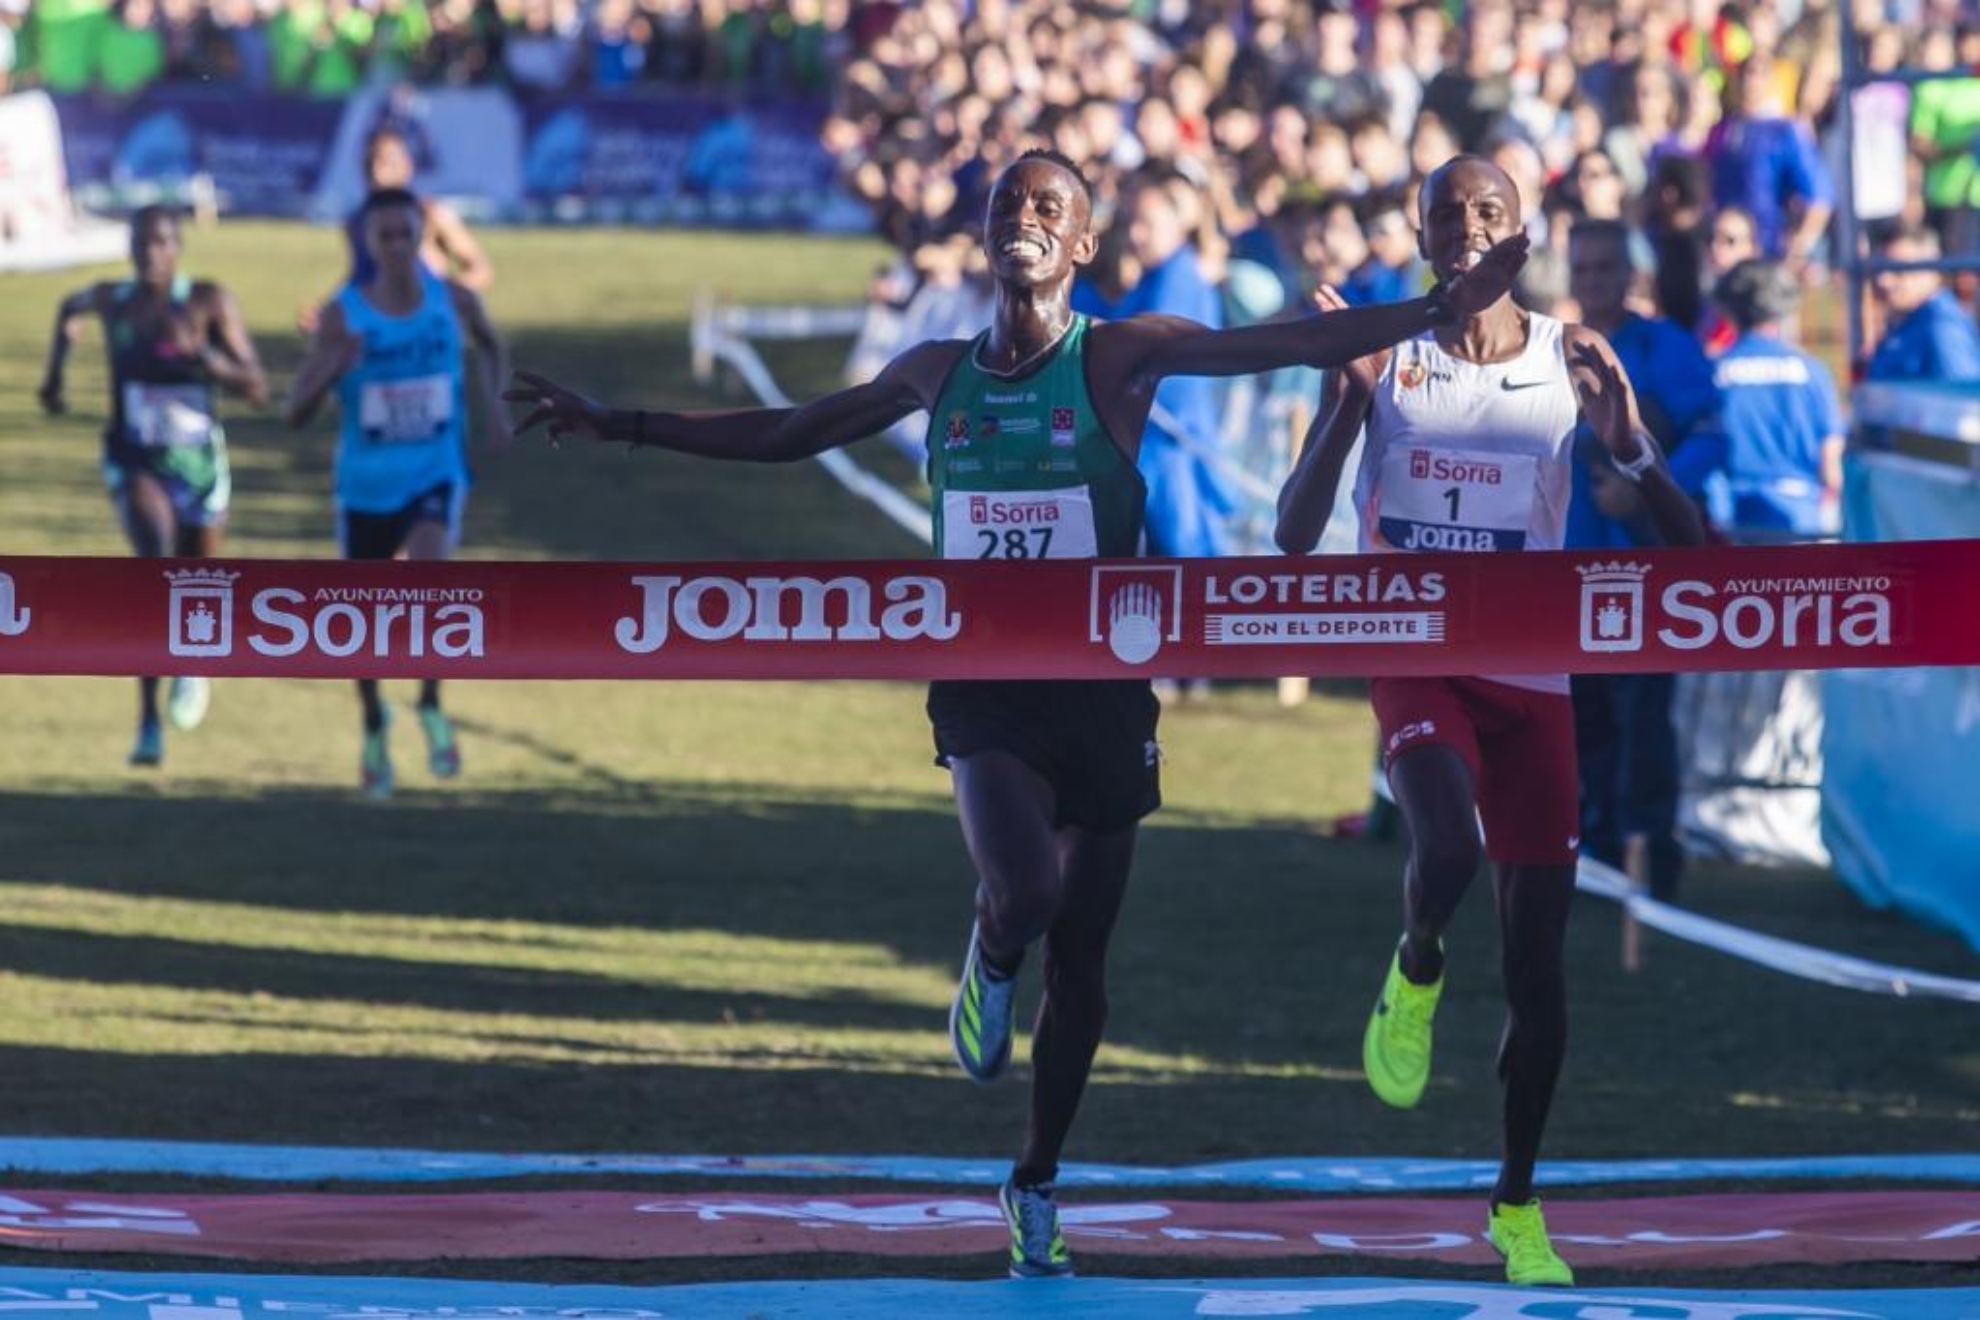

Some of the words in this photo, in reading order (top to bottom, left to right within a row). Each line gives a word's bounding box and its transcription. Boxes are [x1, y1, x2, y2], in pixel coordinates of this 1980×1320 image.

[1432, 458, 1502, 485] Soria
[991, 502, 1060, 524] Soria
[1443, 486, 1460, 522] 1
[977, 526, 1054, 559] 287
[1404, 524, 1500, 553] Joma
[314, 587, 484, 602] AYUNTAMIENTO
[1204, 567, 1446, 604] LOTERÍAS
[1722, 576, 1891, 594] AYUNTAMIENTO
[247, 587, 485, 657] Soria
[614, 575, 962, 654] Joma
[1231, 621, 1278, 636] CON
[1287, 621, 1310, 636] EL
[1317, 620, 1418, 636] DEPORTE
[1657, 580, 1891, 650] Soria
